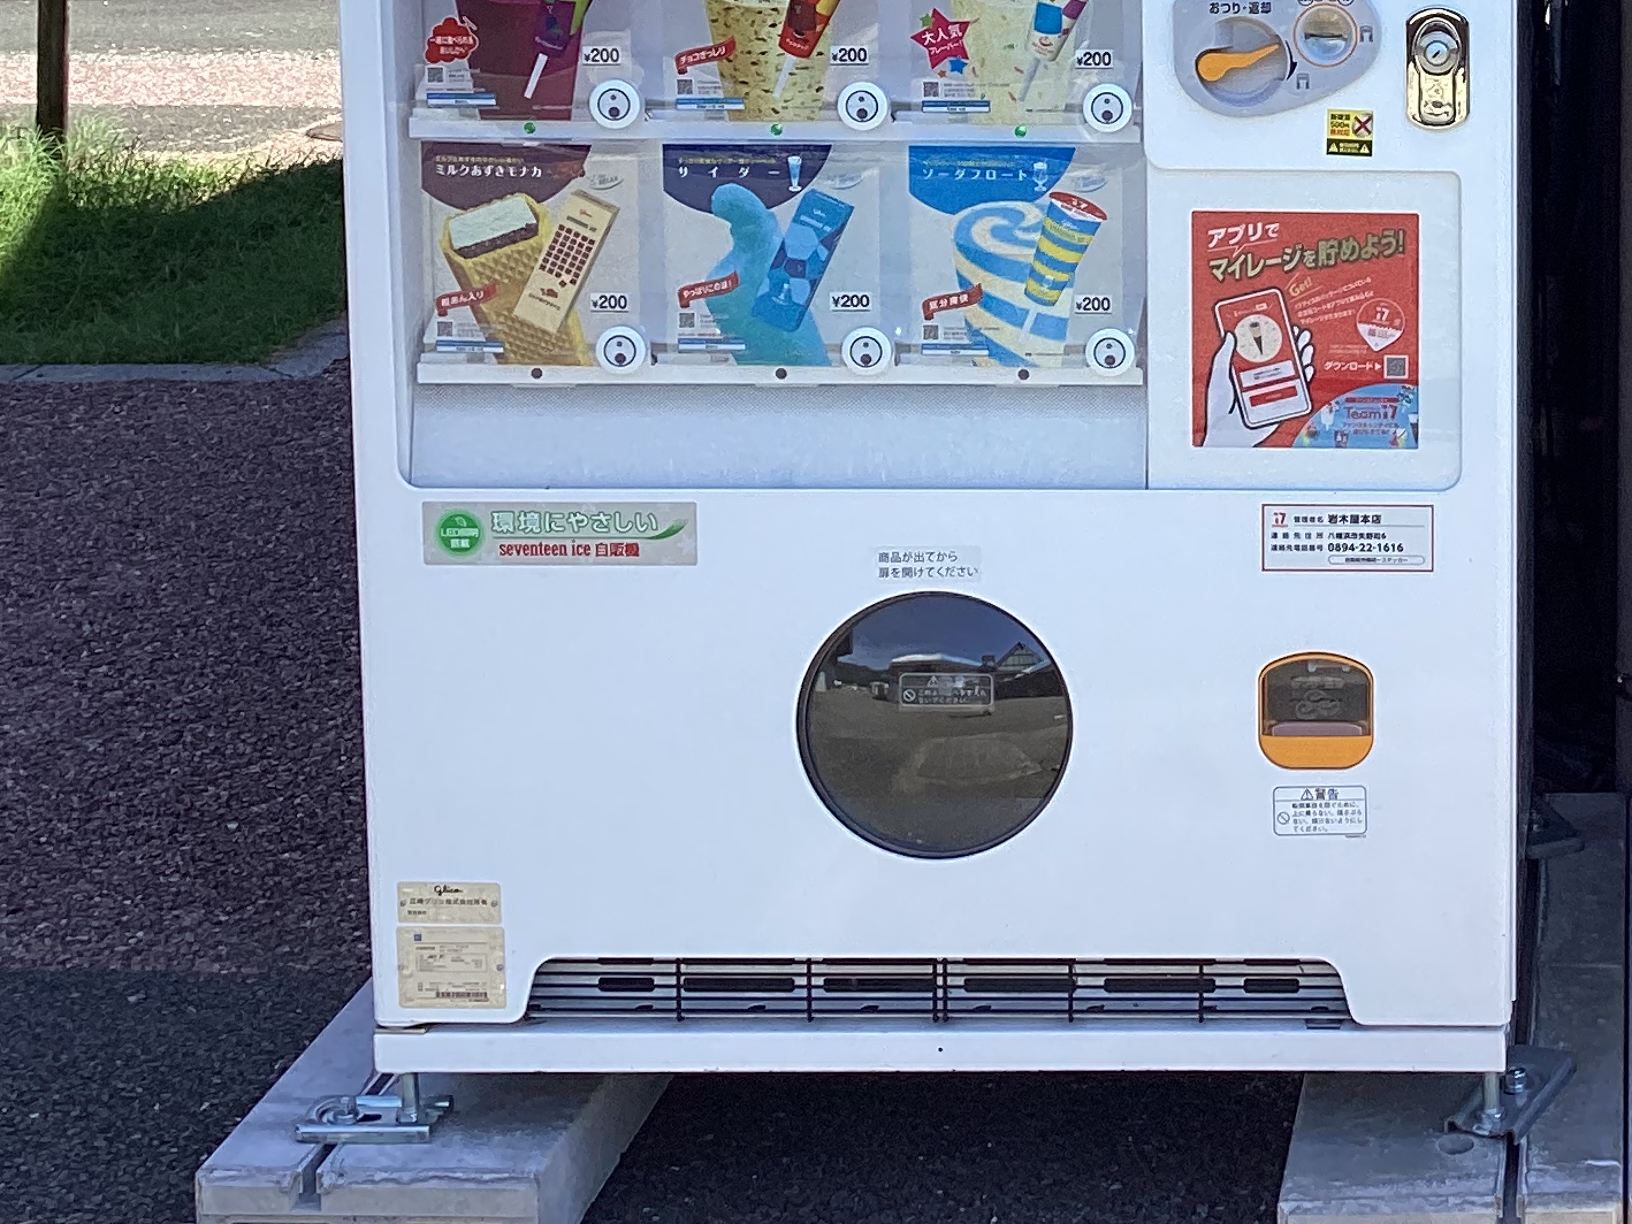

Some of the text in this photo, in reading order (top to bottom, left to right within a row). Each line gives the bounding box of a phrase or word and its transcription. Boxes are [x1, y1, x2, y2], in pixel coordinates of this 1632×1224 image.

[1208, 1, 1273, 15] おつり・返却
[921, 23, 964, 46] 大人気
[583, 47, 621, 63] ¥200
[831, 47, 868, 63] ¥200
[1076, 50, 1112, 67] ¥200
[434, 164, 543, 178] ミルクあずきモナカ
[922, 167, 1028, 181] ソーダフロート
[1207, 221, 1281, 248] アプリで
[1208, 228, 1407, 283] マイレージを貯めよう!
[591, 294, 628, 310] ¥200
[831, 293, 870, 308] ¥200
[1075, 296, 1112, 312] ¥200
[1323, 360, 1374, 371] ダウンロード
[490, 510, 659, 533] 環境にやさしい
[498, 540, 640, 557] seventeen ice 自販機
[1327, 543, 1404, 553] 0894-22-1616
[878, 551, 959, 564] 商品が出てから
[878, 566, 978, 578] 扉を開けてください
